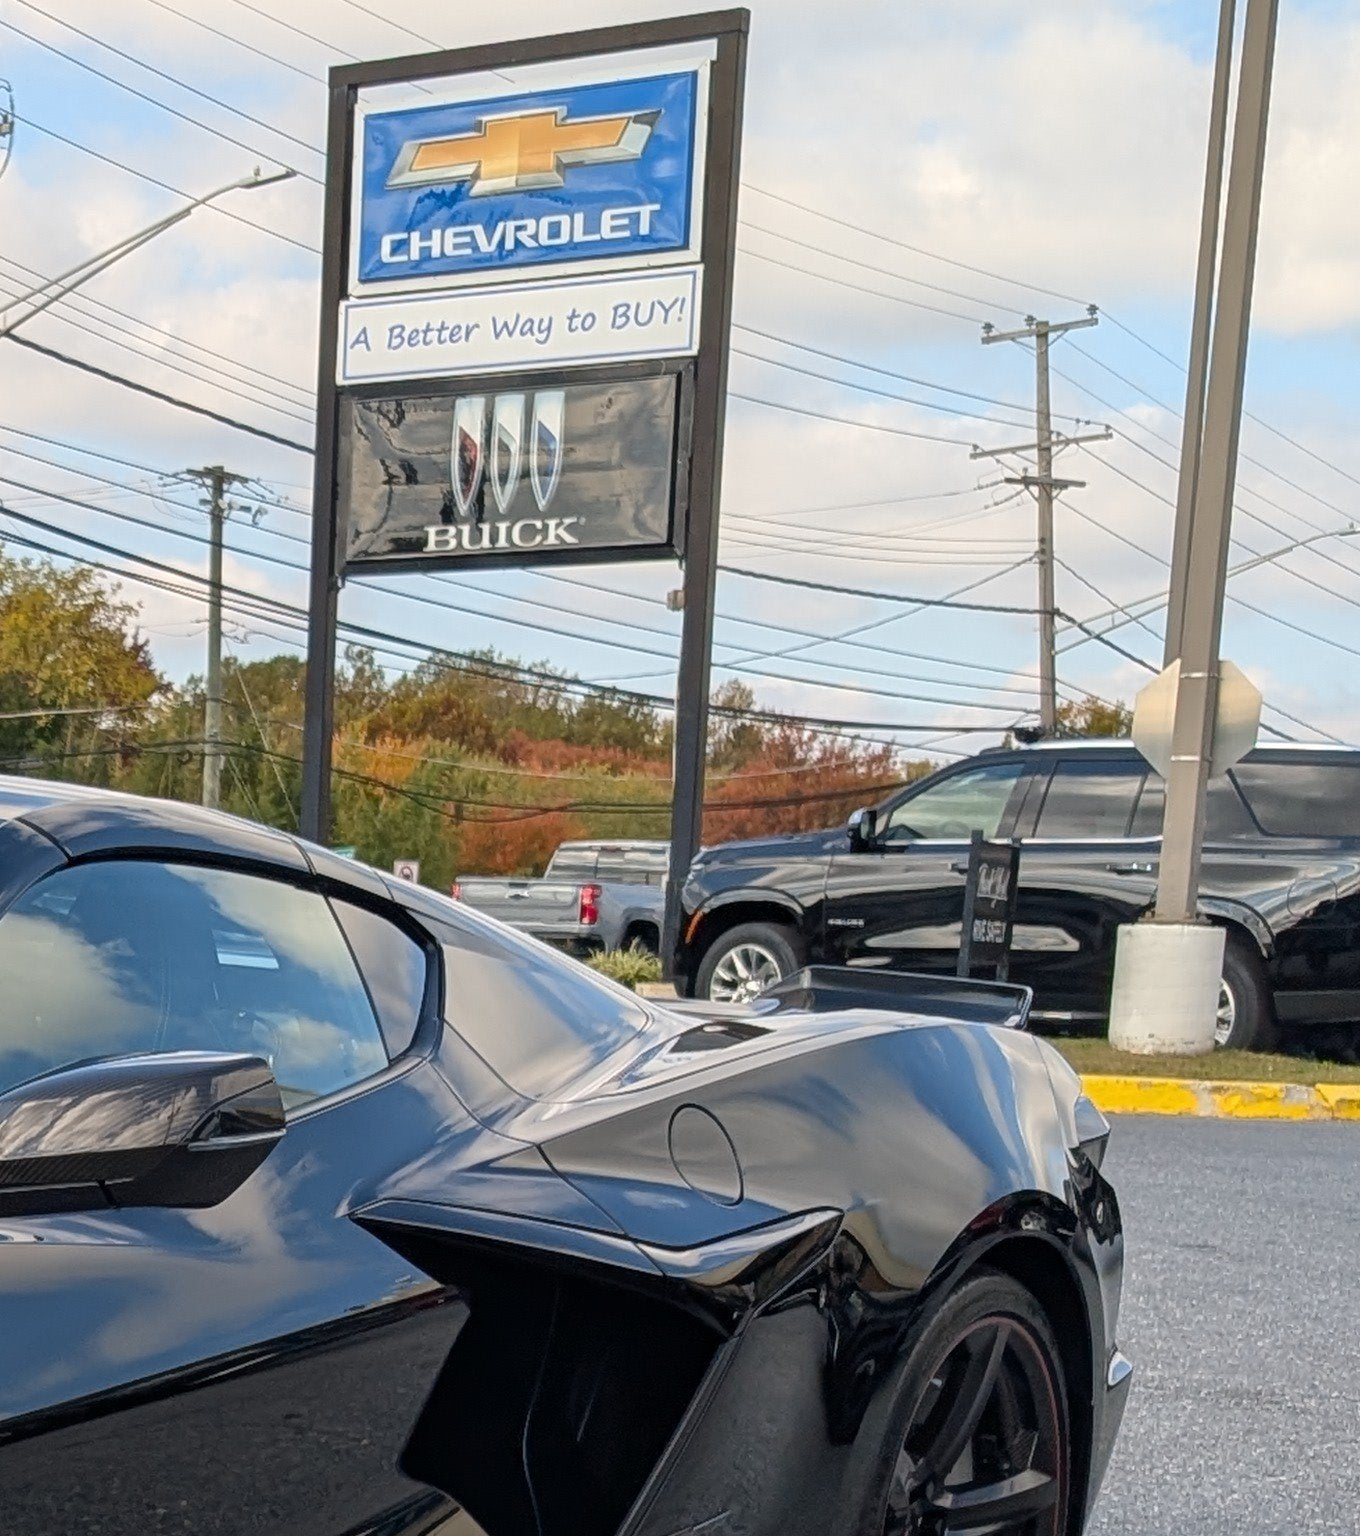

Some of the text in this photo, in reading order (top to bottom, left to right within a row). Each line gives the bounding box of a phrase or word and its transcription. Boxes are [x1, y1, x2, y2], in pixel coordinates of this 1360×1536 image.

[380, 204, 661, 264] CHEVROLET
[349, 296, 686, 353] A Better Way to BUY!
[423, 518, 579, 552] BUICK
